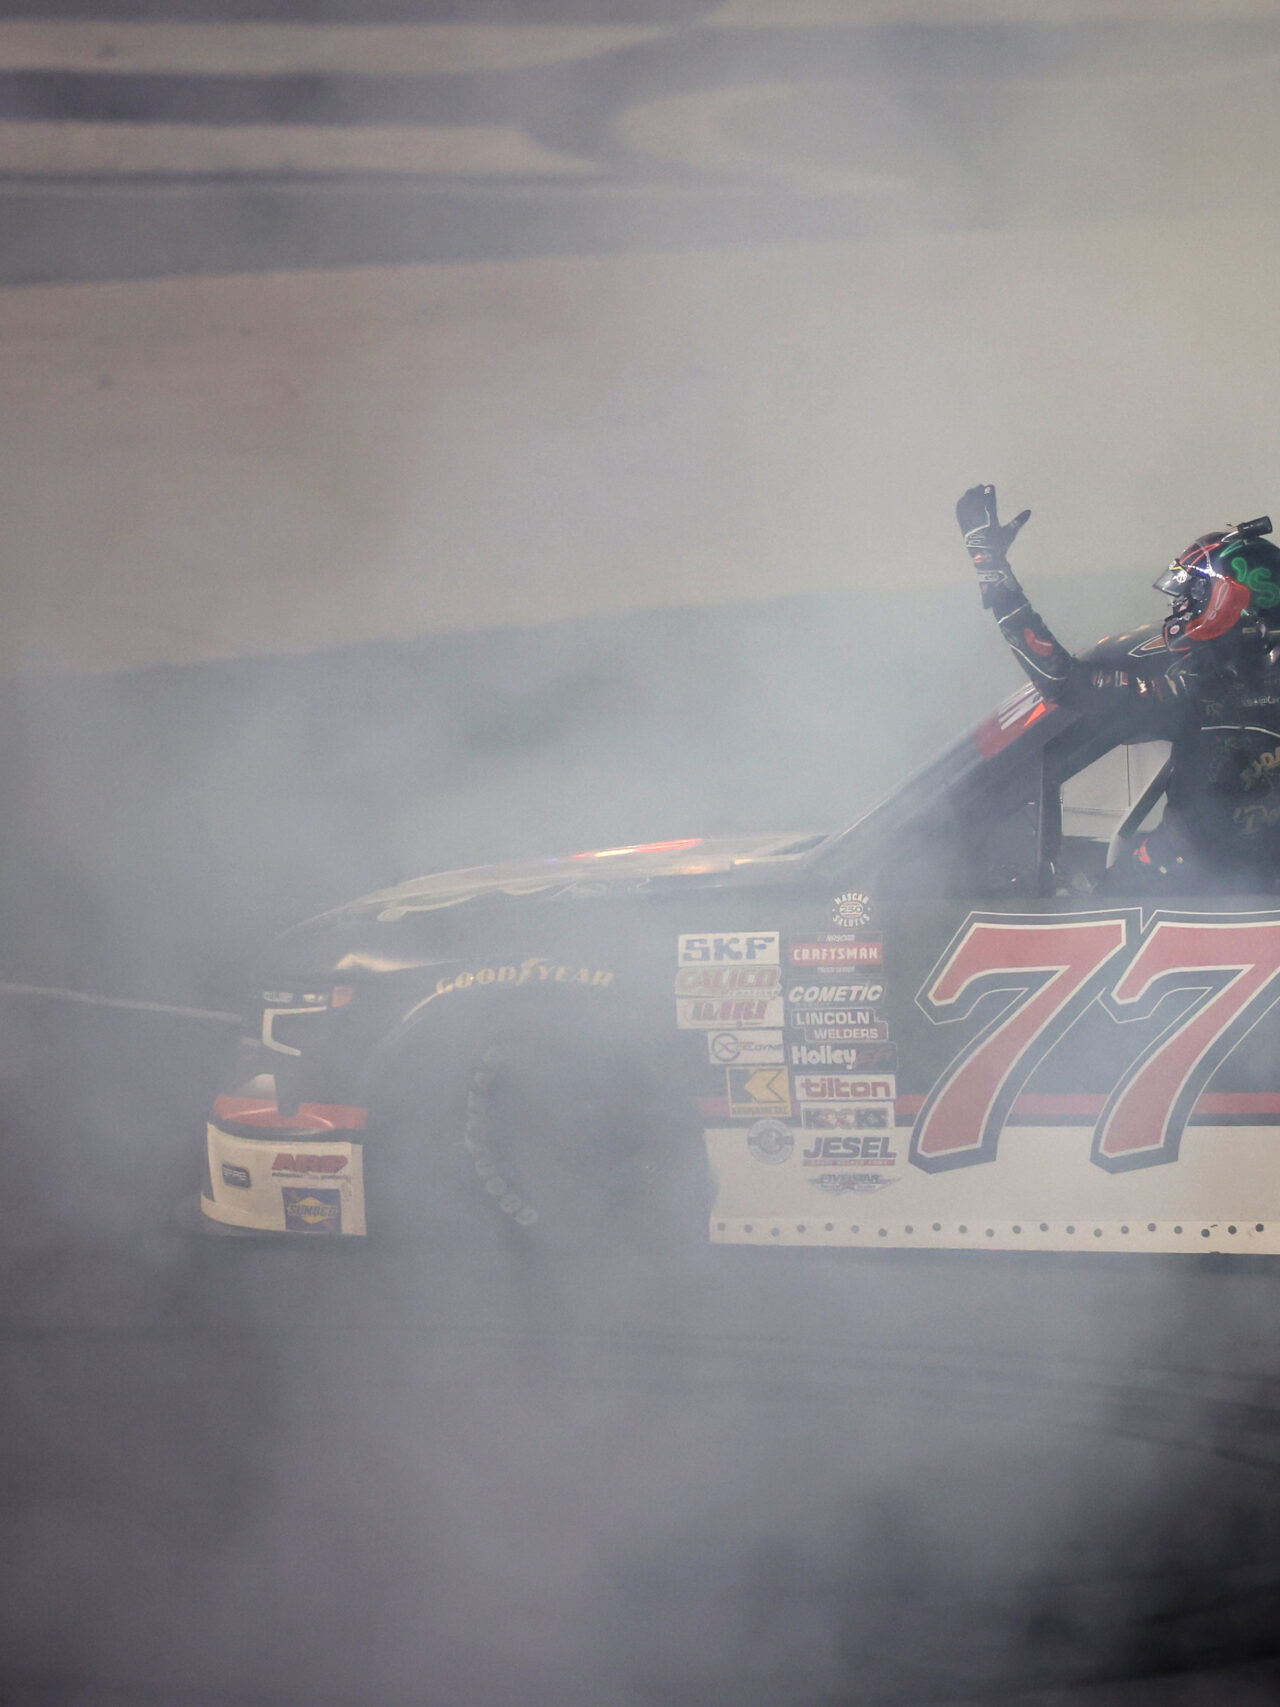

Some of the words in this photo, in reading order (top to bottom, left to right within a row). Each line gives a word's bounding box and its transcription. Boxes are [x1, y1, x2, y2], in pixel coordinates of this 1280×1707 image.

[682, 936, 775, 962] SKF
[793, 947, 878, 961] CRAFTSMAN
[434, 957, 615, 994] GOODYEAR
[788, 984, 884, 1003] COMETIC
[796, 1011, 870, 1025] LINCOLN
[814, 1028, 879, 1039] WELDERS
[791, 1045, 857, 1070] Holley
[800, 1077, 891, 1098] tilton
[802, 1136, 897, 1159] JESEL
[287, 1204, 338, 1217] SUNOCO
